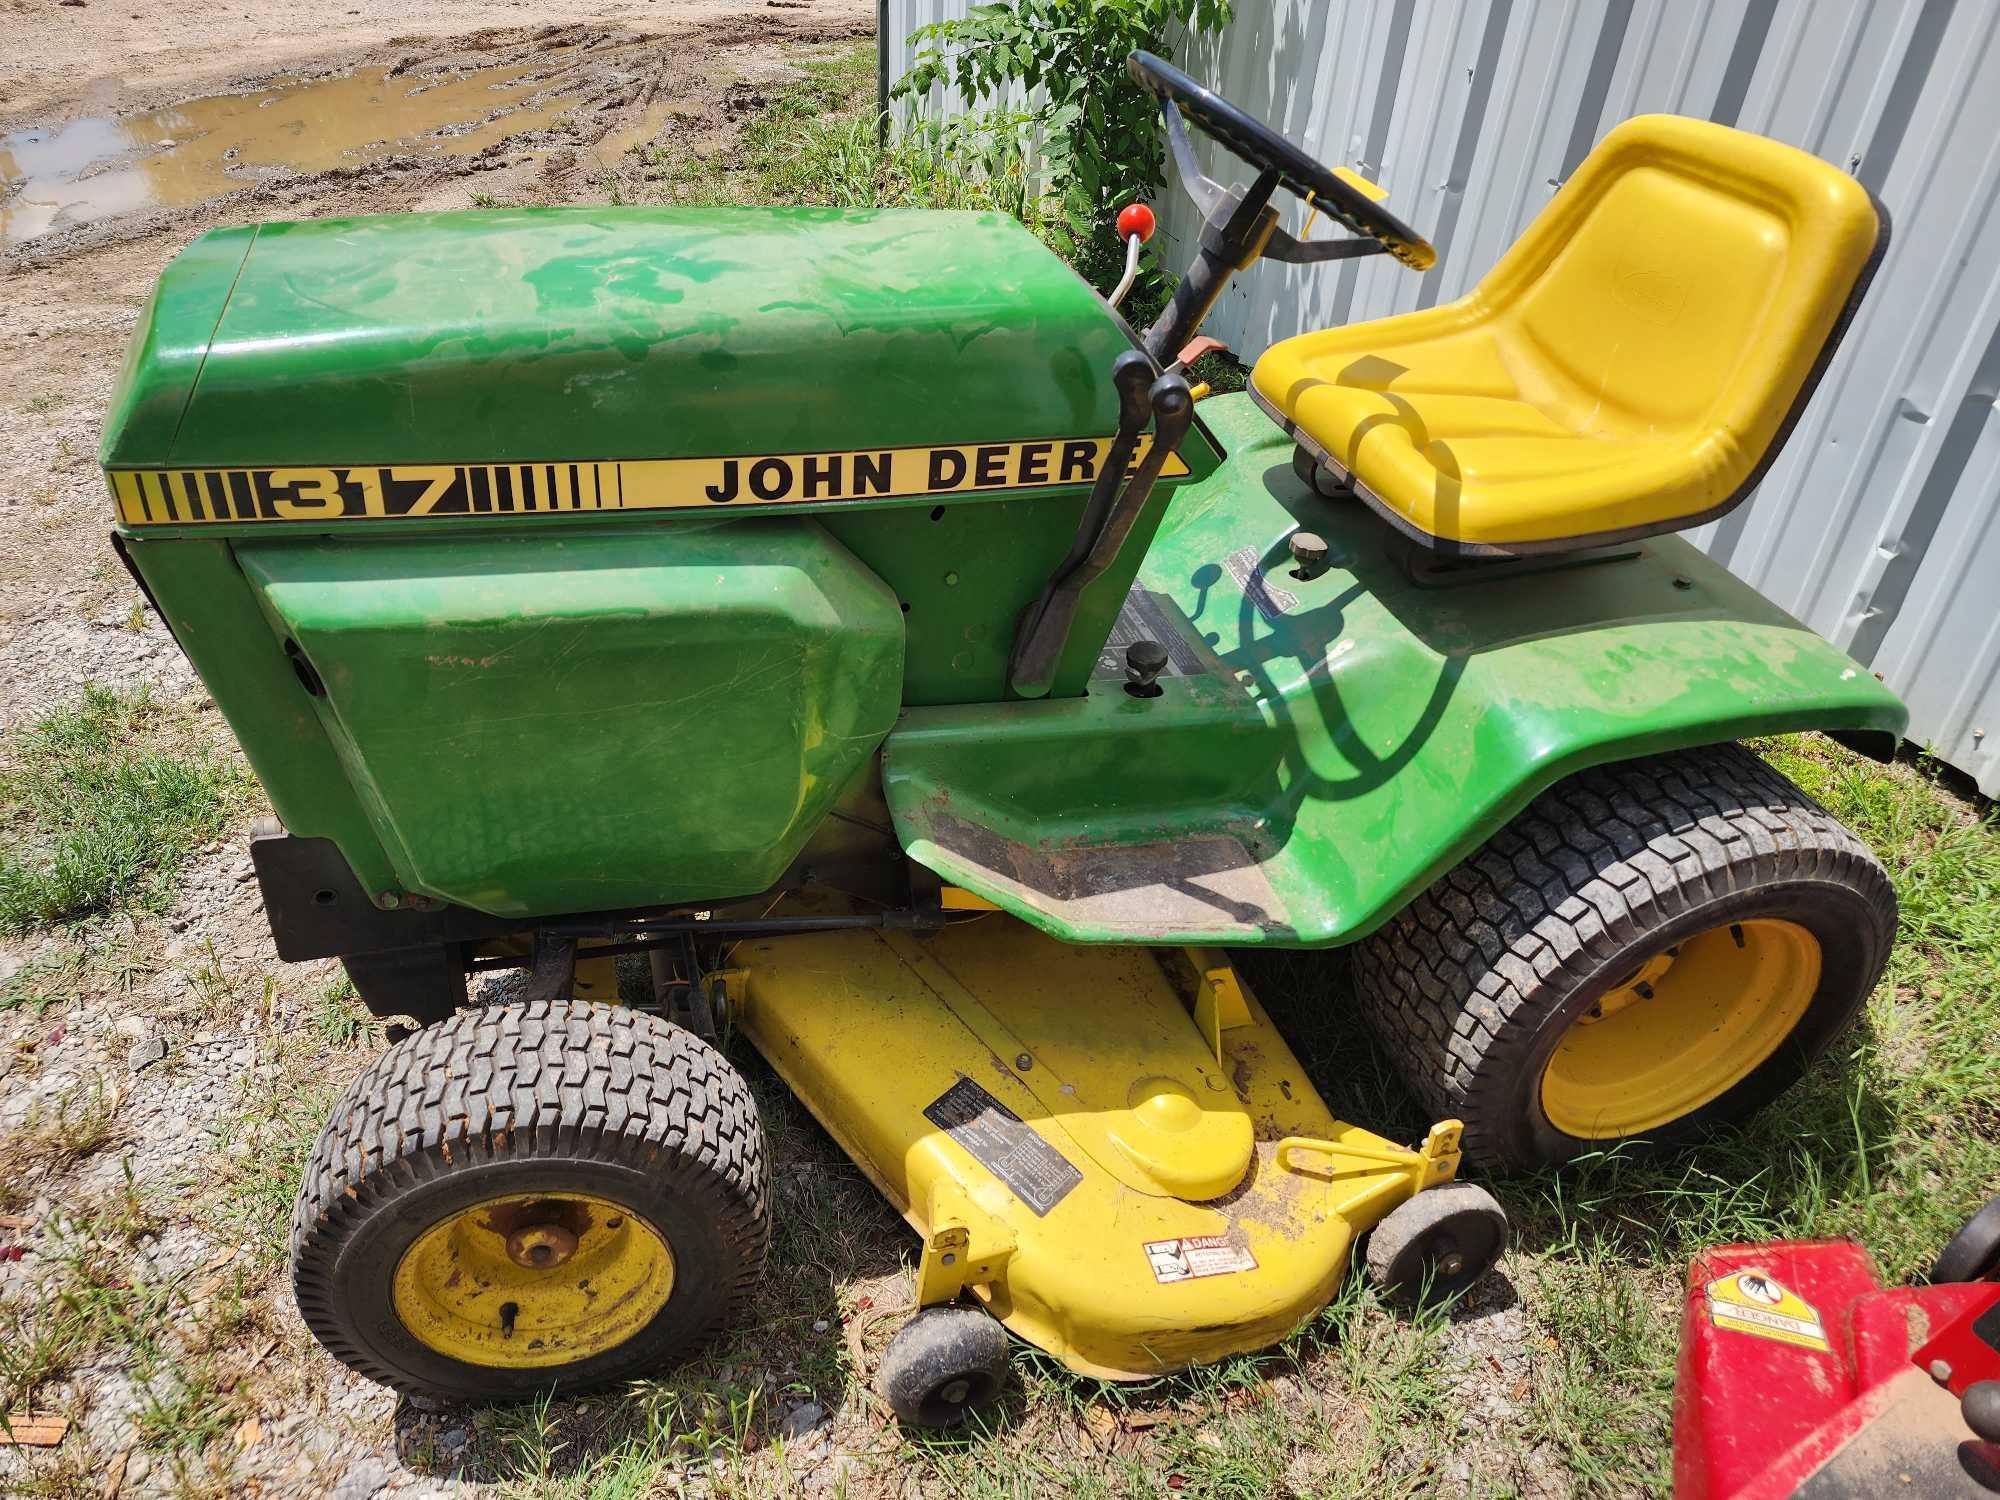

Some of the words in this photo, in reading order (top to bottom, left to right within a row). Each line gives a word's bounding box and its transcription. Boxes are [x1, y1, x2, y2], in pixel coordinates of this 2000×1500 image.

[705, 453, 893, 502] JOHN
[927, 438, 1142, 490] DEER
[269, 467, 458, 519] 317
[1192, 1236, 1227, 1249] DANG
[1736, 1306, 1801, 1331] DANGER
